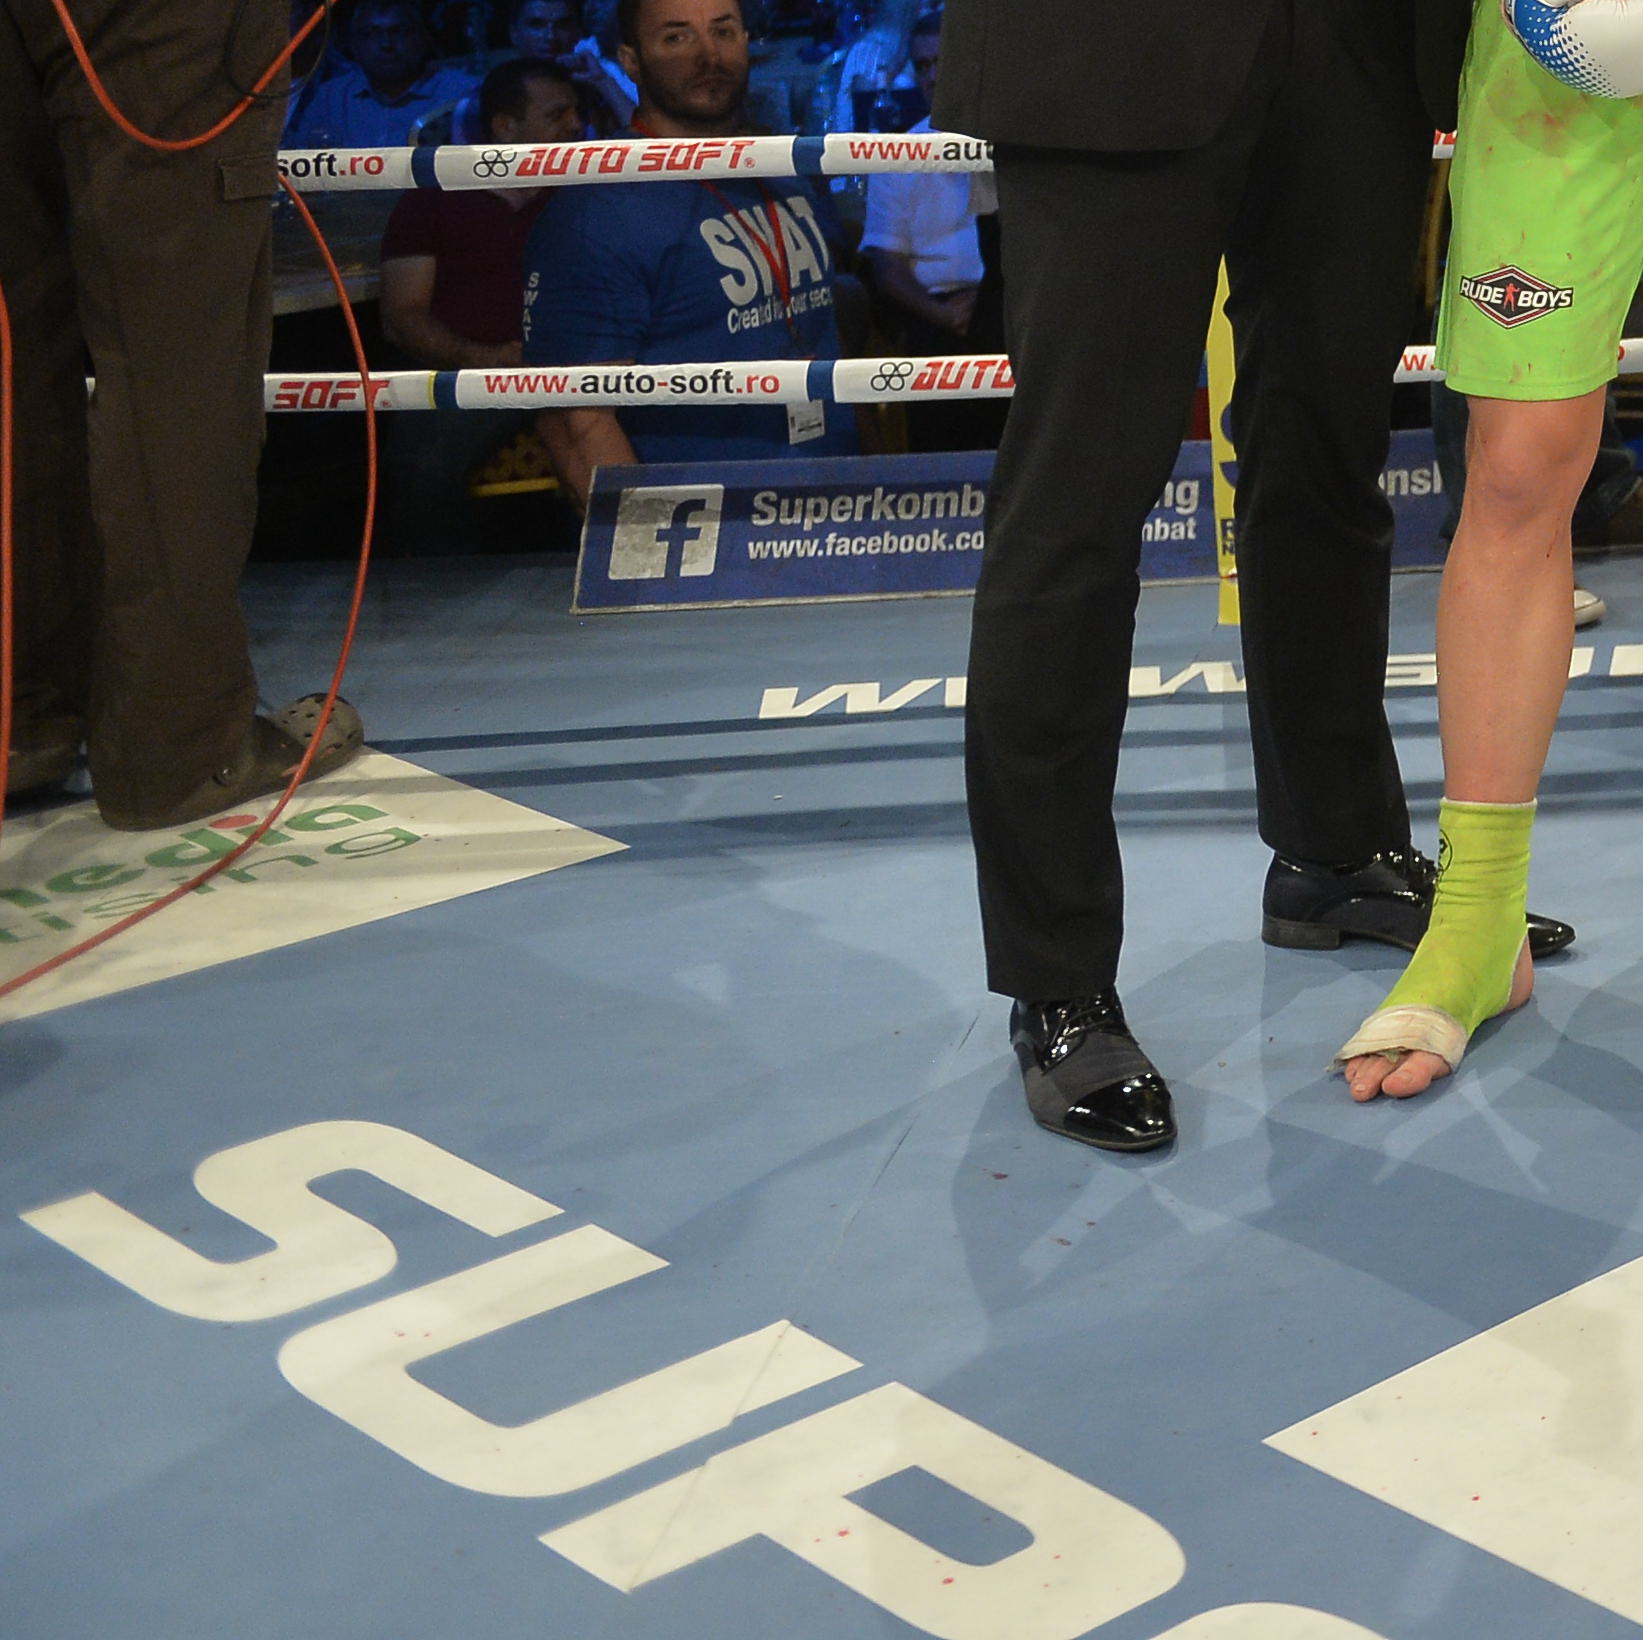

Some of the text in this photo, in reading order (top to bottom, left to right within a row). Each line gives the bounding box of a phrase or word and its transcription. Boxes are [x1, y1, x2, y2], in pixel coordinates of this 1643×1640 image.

[514, 140, 756, 178] AUTO SOFT
[700, 196, 830, 307] SWAT
[1460, 280, 1574, 310] RUDE BOYS
[272, 379, 391, 410] SOFT
[484, 368, 781, 397] www.auto-soft.ro
